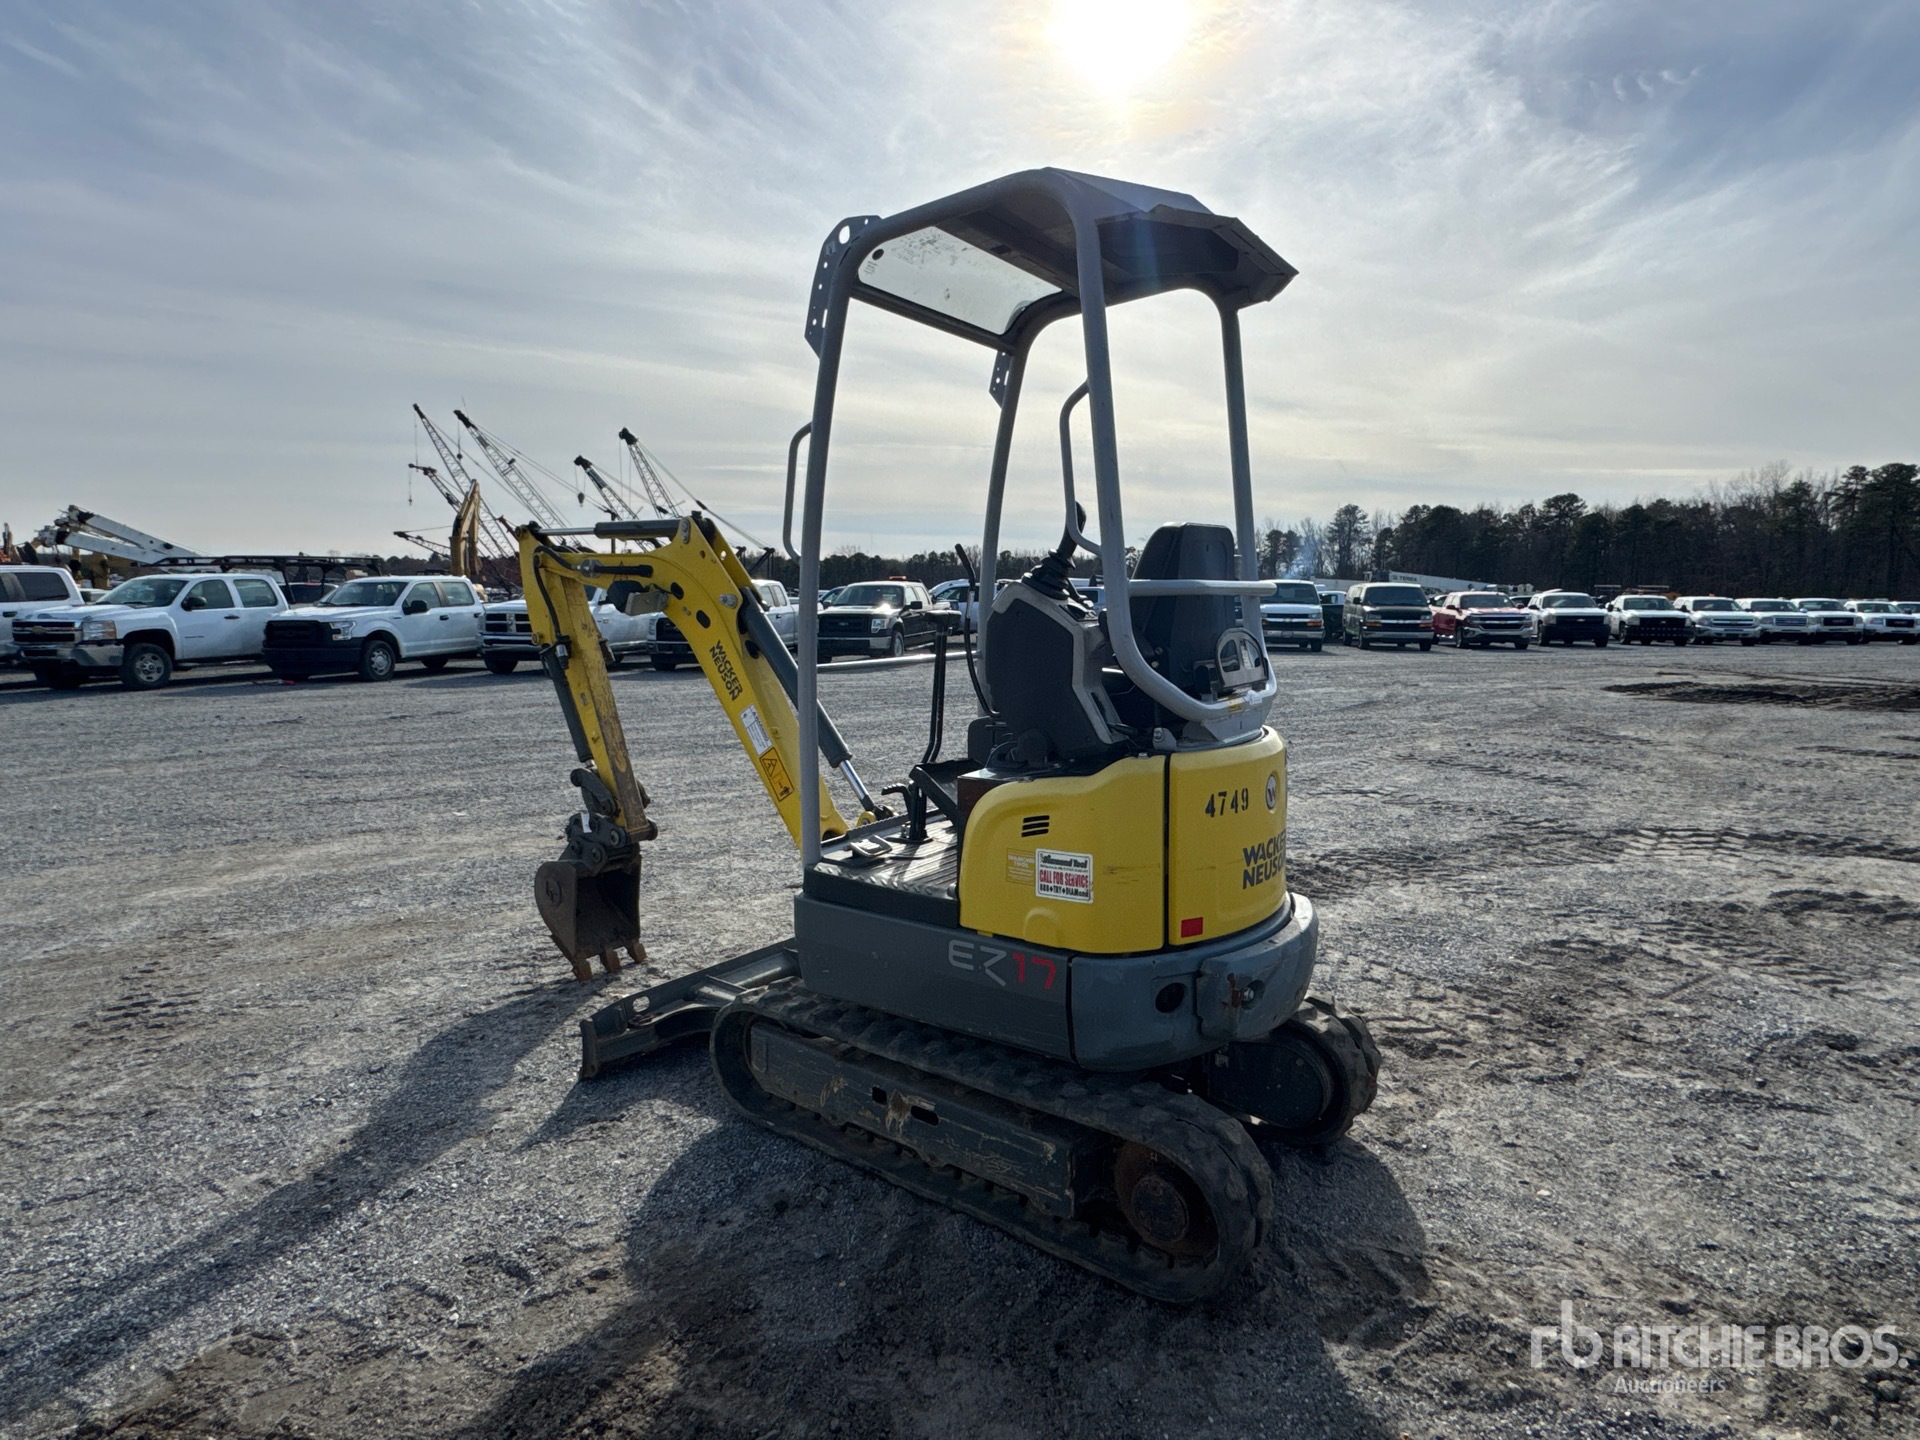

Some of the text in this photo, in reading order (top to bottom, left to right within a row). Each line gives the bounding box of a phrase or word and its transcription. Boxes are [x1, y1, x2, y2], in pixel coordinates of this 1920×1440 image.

[709, 646, 740, 701] NEUSON
[716, 639, 743, 693] WACKER
[1205, 787, 1249, 818] 4749
[1040, 869, 1053, 884] CALL
[1053, 870, 1064, 885] FOR
[1065, 872, 1089, 888] SERVICE
